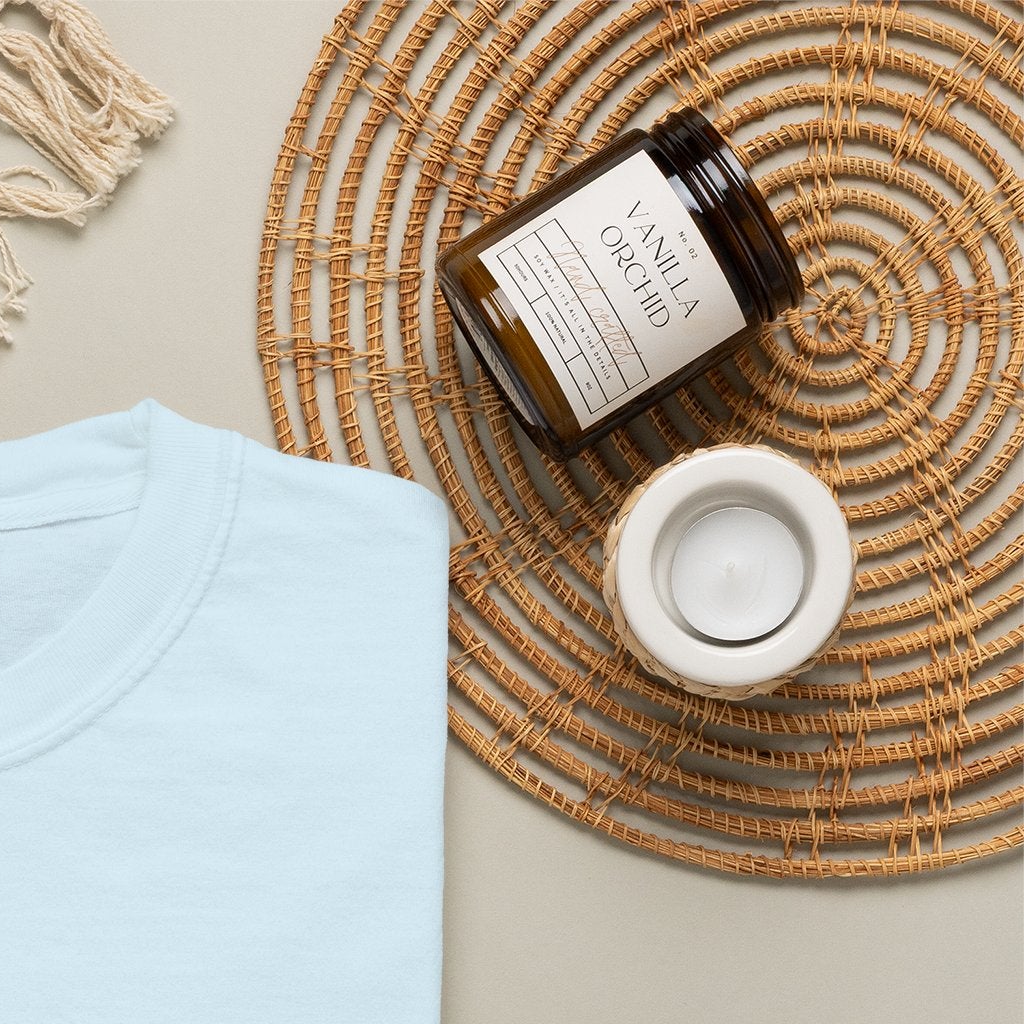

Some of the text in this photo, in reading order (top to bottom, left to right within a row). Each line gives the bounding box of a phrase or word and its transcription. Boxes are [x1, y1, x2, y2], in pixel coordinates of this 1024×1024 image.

[600, 225, 670, 328] ORCHID
[626, 200, 700, 319] VANILLA
[688, 247, 698, 260] 02
[533, 254, 544, 267] SOY
[543, 268, 555, 284] WAX
[558, 291, 570, 307] IT'S
[568, 308, 579, 323] ALL
[578, 324, 586, 334] IN
[584, 335, 596, 350] THE
[593, 351, 612, 381] DETAILS
[553, 323, 567, 345] NATURAL
